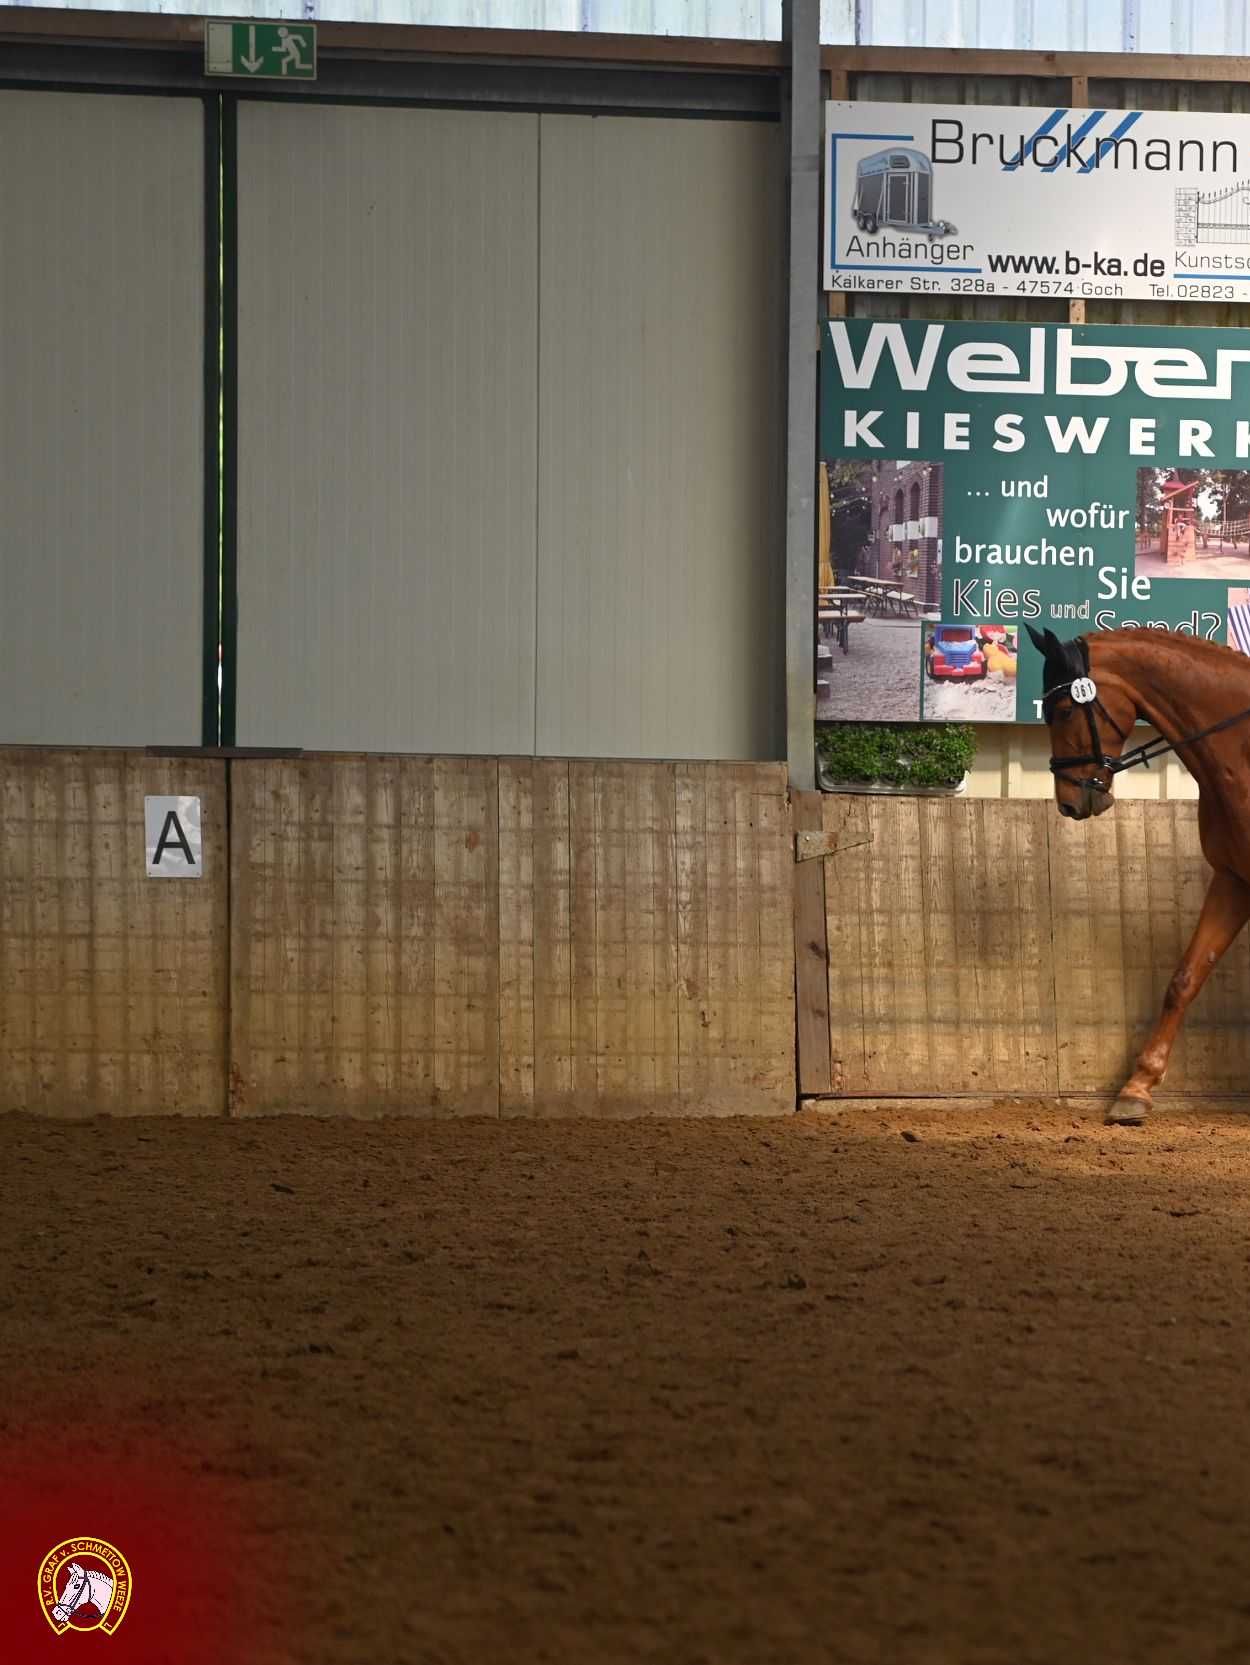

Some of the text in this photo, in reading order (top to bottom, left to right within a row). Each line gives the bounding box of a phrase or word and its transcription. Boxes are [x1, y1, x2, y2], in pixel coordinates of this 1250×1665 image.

[931, 119, 1239, 173] Bruckmann
[846, 236, 974, 265] Anhänger
[988, 250, 1165, 277] www.b-ka.de
[831, 275, 903, 290] Kalkarer
[911, 277, 941, 290] Str.
[951, 279, 994, 292] 328a
[1016, 280, 1074, 294] 47574
[1081, 282, 1123, 297] Goch
[1001, 475, 1048, 498] und
[1046, 502, 1129, 529] wofür
[955, 536, 1094, 566] brauchen
[1098, 567, 1150, 600] Sie
[953, 579, 1089, 618] Kies und
[1075, 682, 1092, 698] 361
[152, 811, 195, 864] A
